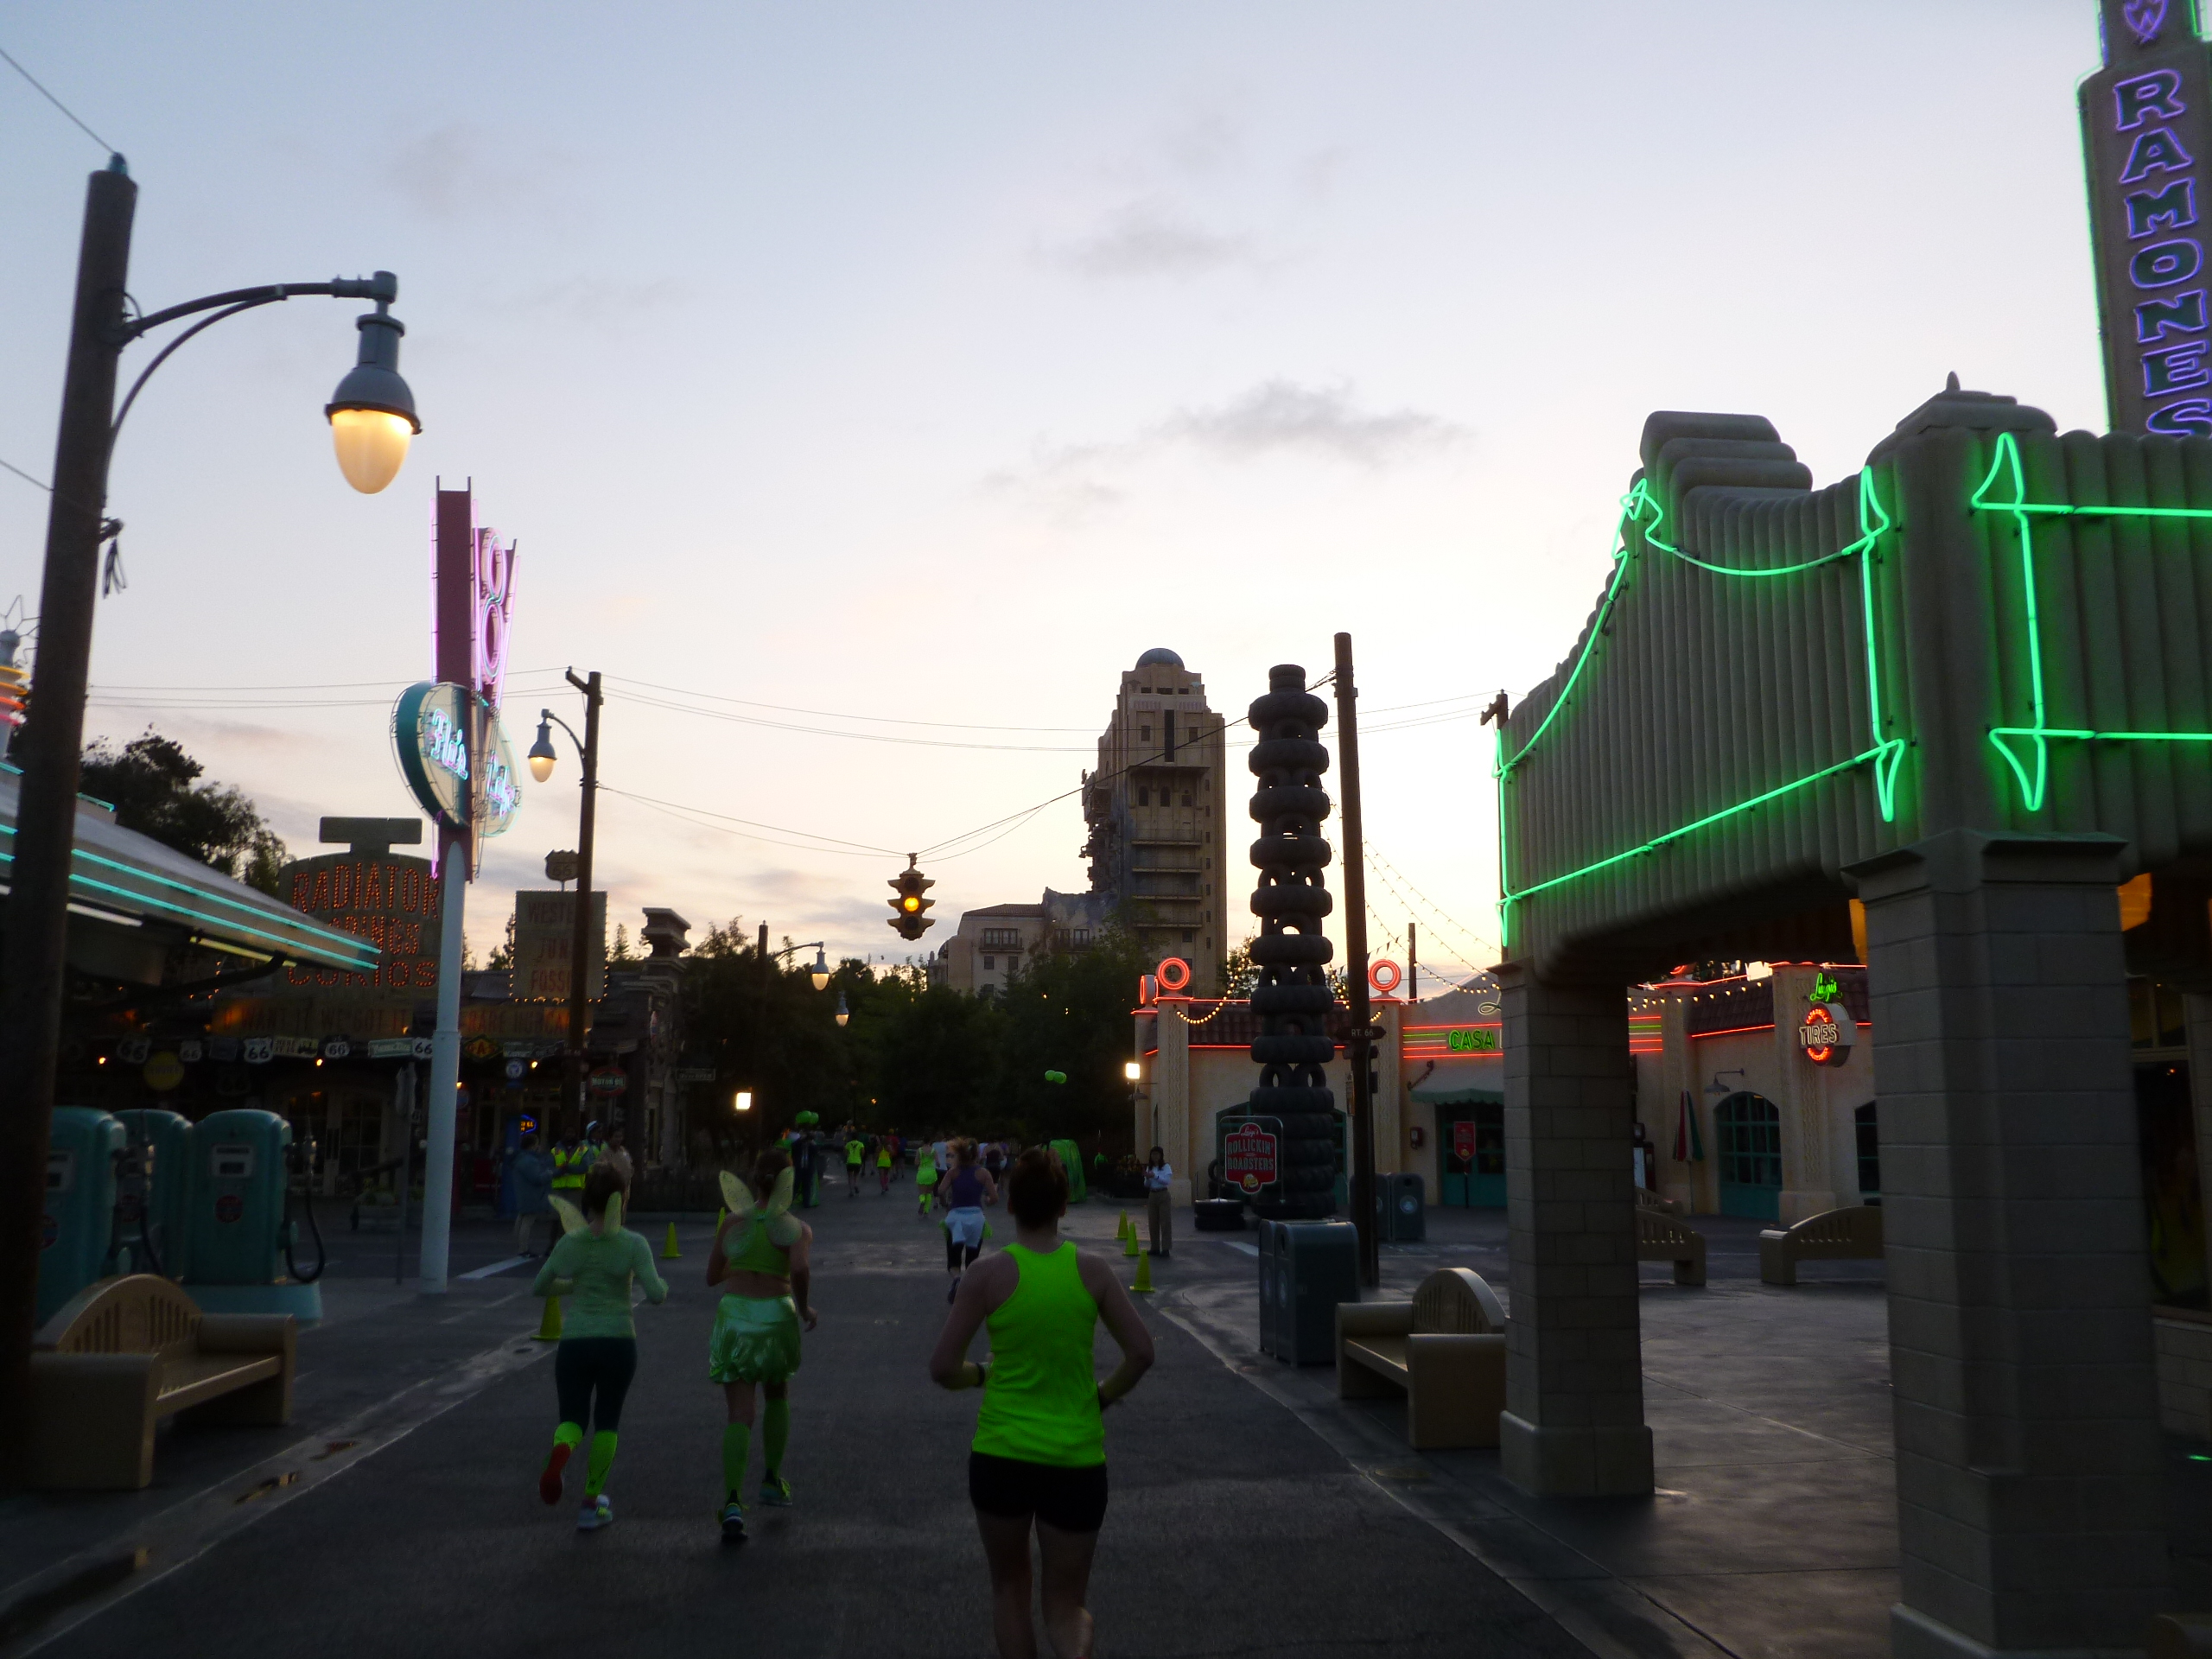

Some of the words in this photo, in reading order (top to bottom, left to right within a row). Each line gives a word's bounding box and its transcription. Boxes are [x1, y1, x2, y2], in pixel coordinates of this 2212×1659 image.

[291, 862, 440, 919] RADIATOR
[528, 900, 592, 925] WESTE
[534, 938, 570, 960] JUN
[530, 969, 572, 994] FOSSI
[1364, 1028, 1375, 1037] 66
[1448, 1029, 1496, 1052] CASA
[1799, 1024, 1838, 1046] TIRES
[248, 1046, 270, 1059] 66
[328, 1044, 346, 1056] 66
[415, 1041, 432, 1055] 66
[467, 1041, 497, 1055] GAS
[1227, 1157, 1274, 1171] ROADSTERS
